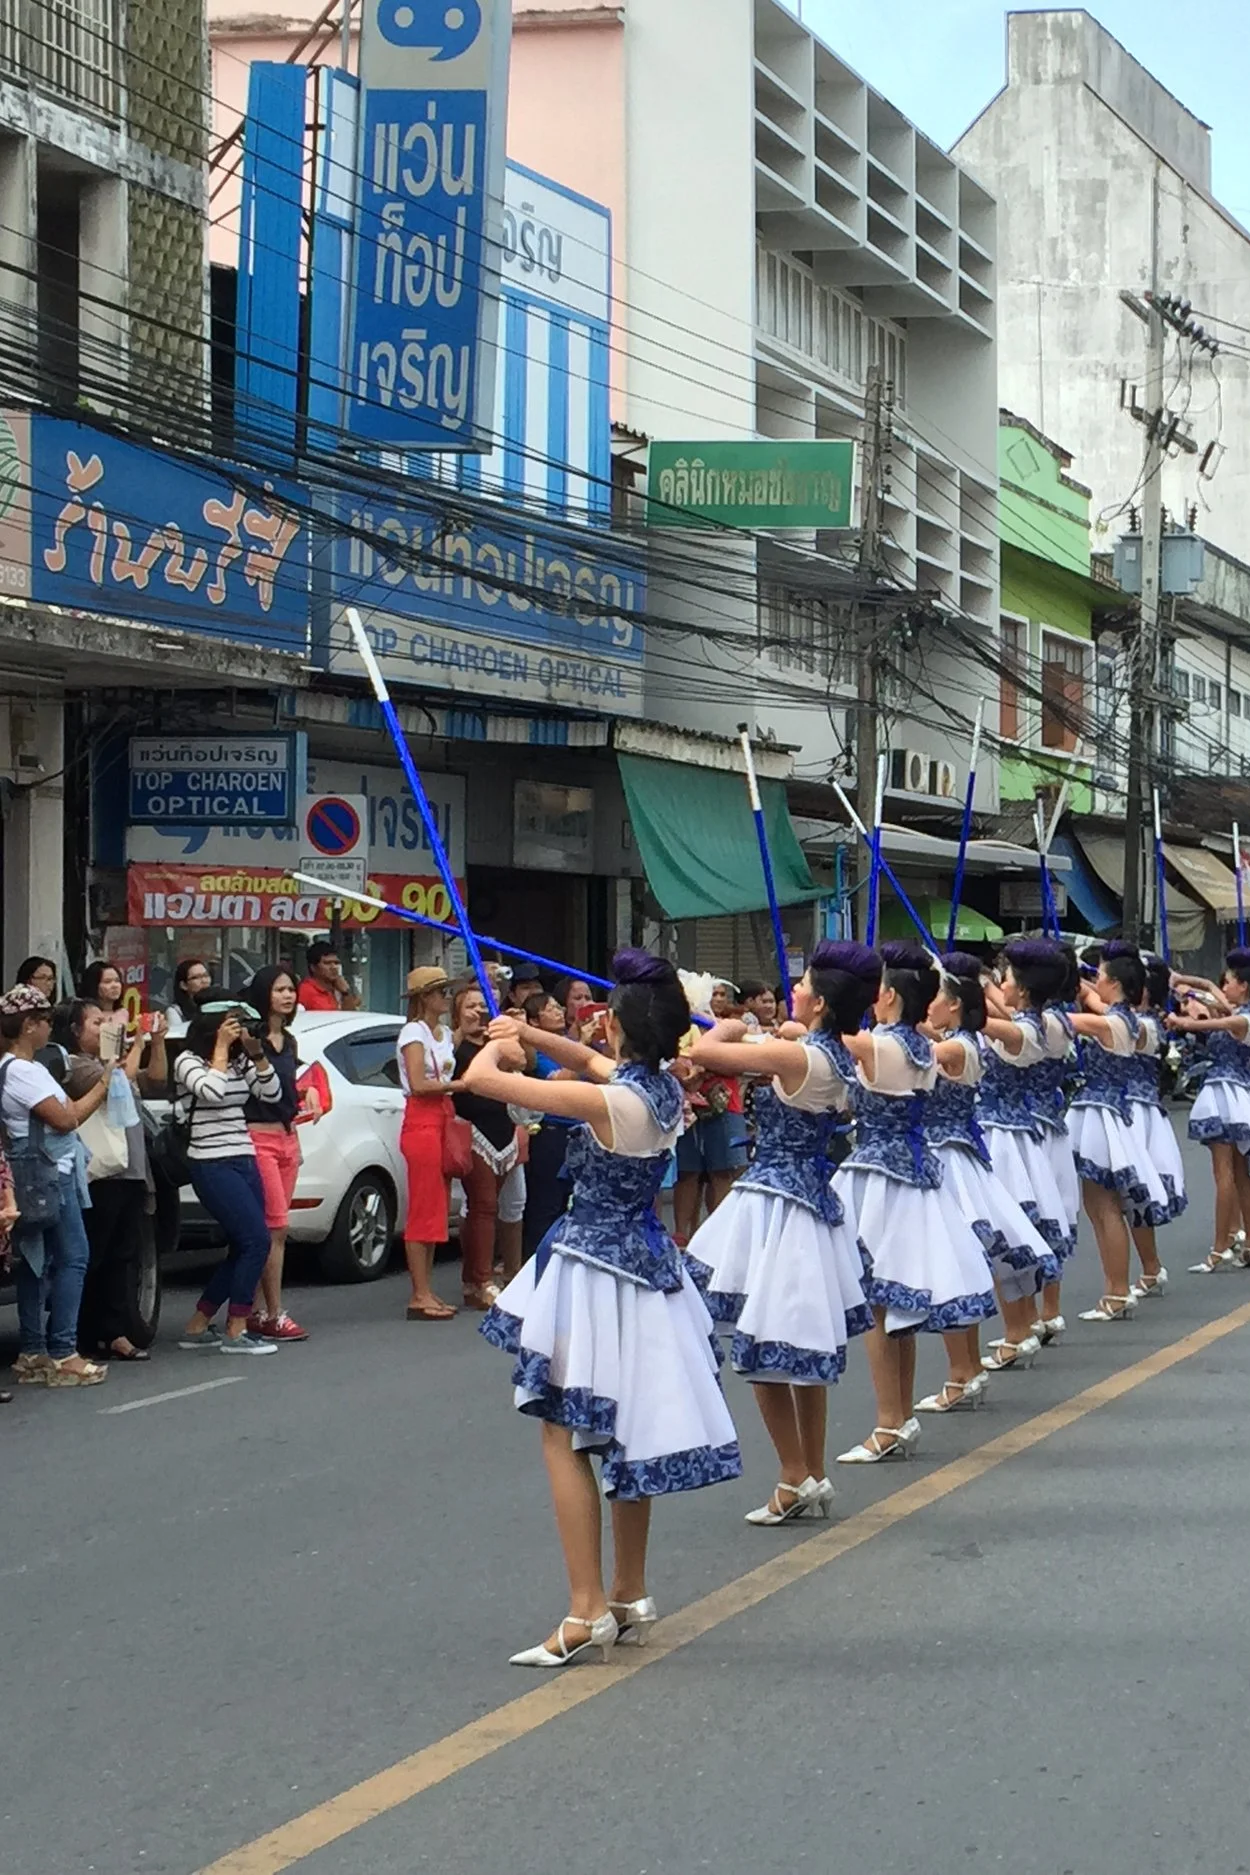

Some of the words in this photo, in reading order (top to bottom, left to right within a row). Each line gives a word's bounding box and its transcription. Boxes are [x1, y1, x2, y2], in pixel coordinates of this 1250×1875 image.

[372, 101, 475, 197] แว่น
[374, 202, 466, 309] ท็อป
[357, 328, 470, 429] เจริญ
[410, 633, 528, 683] CHAROEN
[538, 657, 627, 698] OPTICAL
[134, 772, 172, 792] TOP
[187, 772, 282, 792] CHAROEN
[147, 796, 267, 815] OPTICAL
[144, 886, 261, 920] แว่นตา
[270, 896, 319, 922] ลด
